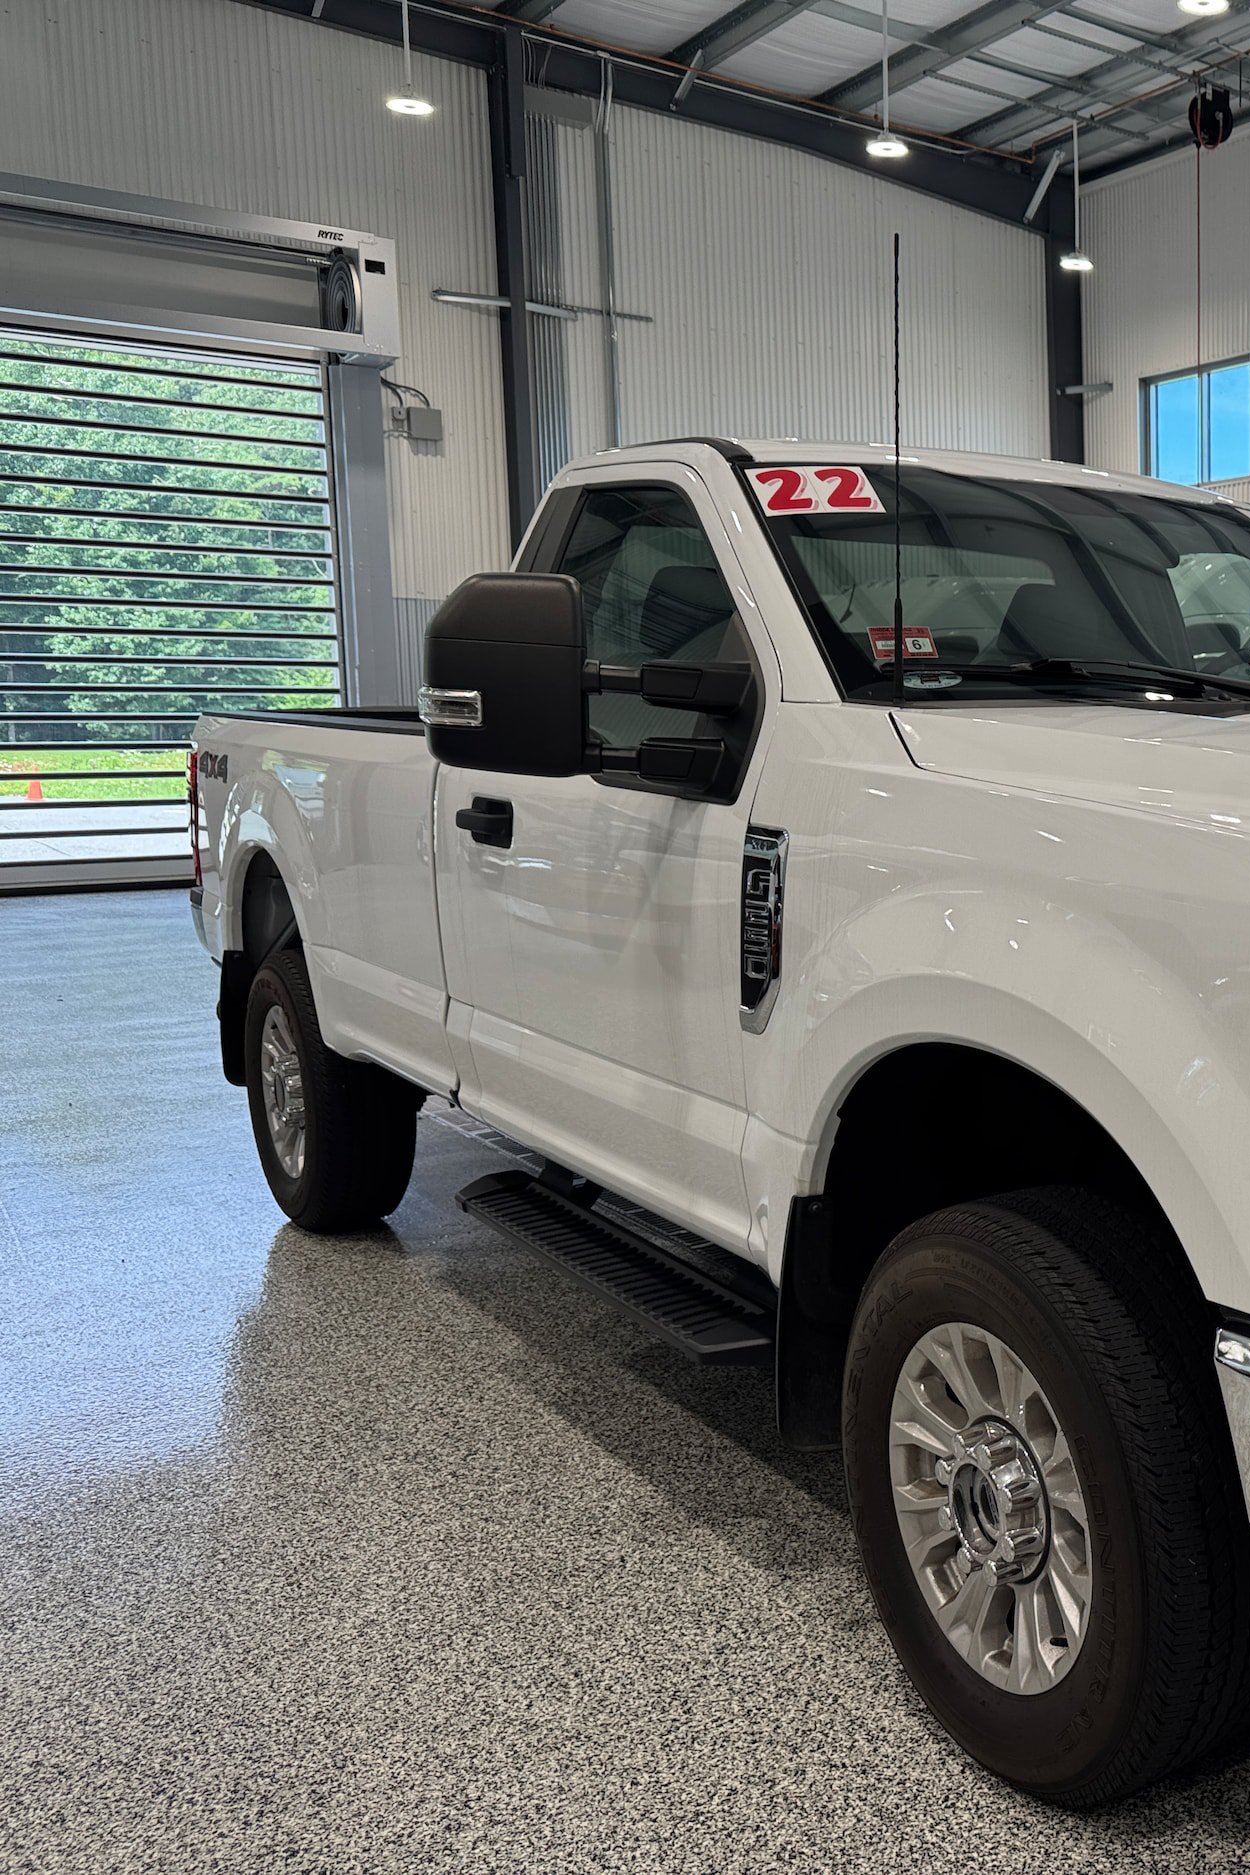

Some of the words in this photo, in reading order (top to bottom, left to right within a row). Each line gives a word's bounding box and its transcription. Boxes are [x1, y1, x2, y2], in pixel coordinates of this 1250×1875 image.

[317, 229, 344, 242] RYTEC
[755, 468, 878, 512] 22
[911, 639, 922, 650] 6
